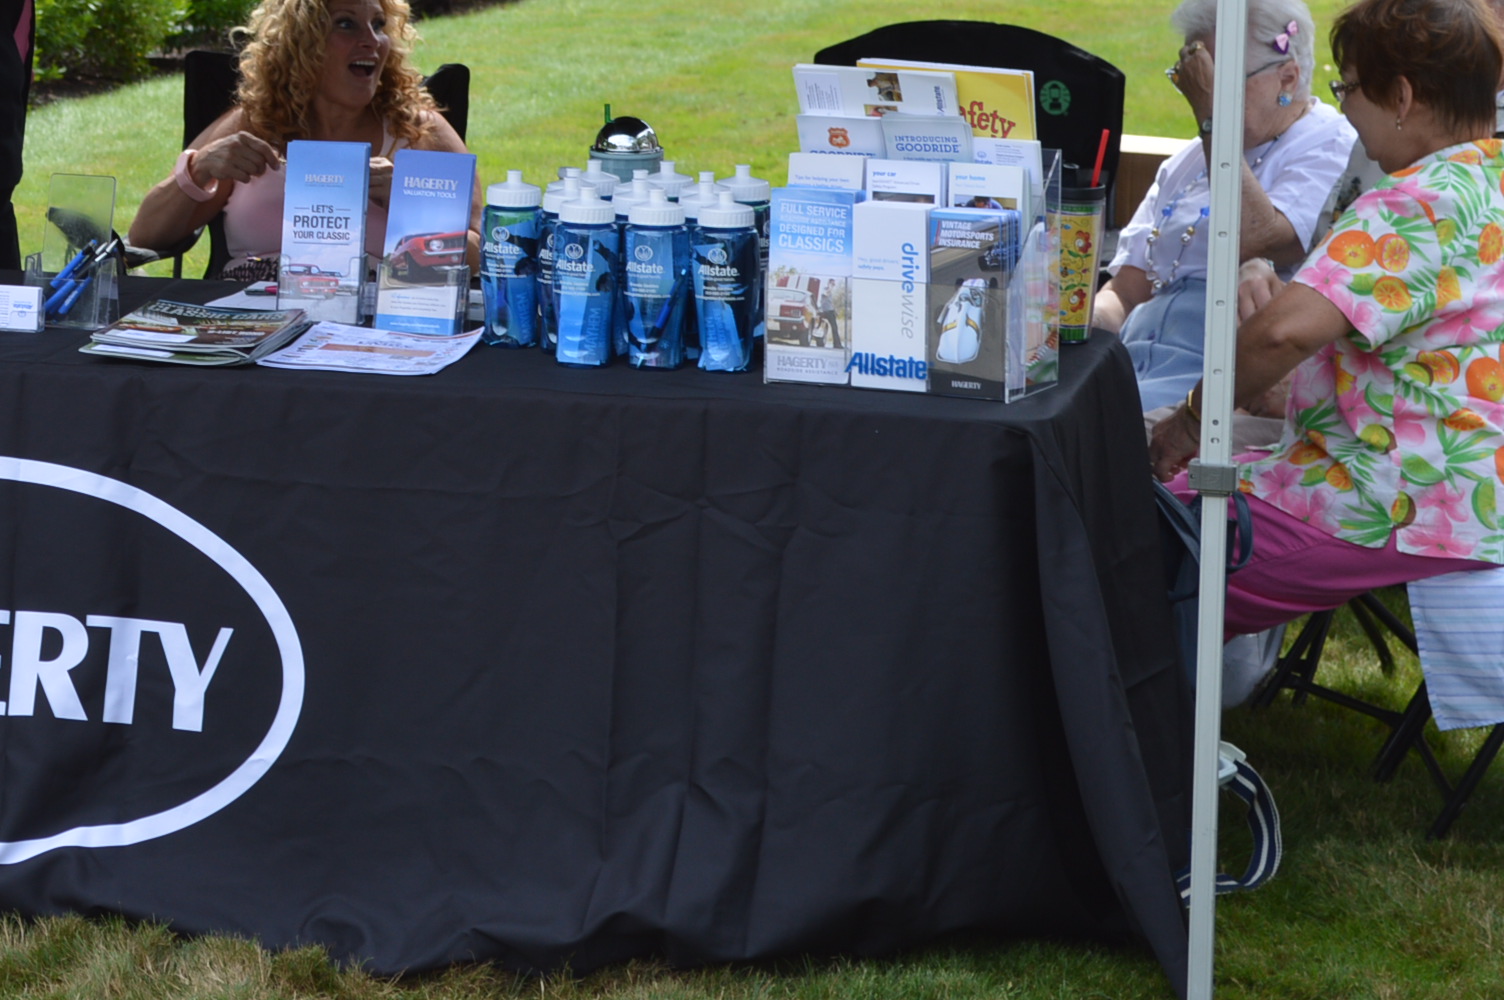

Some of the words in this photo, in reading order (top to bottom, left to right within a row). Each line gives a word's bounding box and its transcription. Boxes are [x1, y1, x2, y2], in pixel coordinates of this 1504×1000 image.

[894, 135, 958, 144] INTRODUCING
[896, 143, 960, 153] GOODRIDE
[304, 173, 345, 184] HAGERTY
[404, 176, 459, 191] HAGERTY
[403, 189, 436, 199] VALUATION
[436, 190, 457, 199] TOOLS
[311, 205, 334, 214] LET'S
[781, 202, 804, 216] FULL
[806, 205, 847, 219] SERVICE
[293, 215, 351, 230] PROTECT
[941, 220, 973, 230] VINTAGE
[293, 230, 314, 240] YOUR
[316, 231, 350, 241] CLASSIC
[779, 223, 825, 236] DESIGNED
[827, 226, 846, 238] FOR
[940, 229, 994, 241] MOTORSPORTS
[483, 242, 521, 255] Allstate
[778, 233, 845, 253] CLASSICS
[938, 238, 981, 249] INSURANCE
[556, 259, 594, 272] Allstate
[626, 261, 664, 274] Allstate
[698, 264, 739, 277] Allstate
[583, 307, 602, 355] MAYHEM
[777, 355, 827, 370] HAGERTY
[844, 352, 929, 381] Allstate
[951, 380, 982, 390] HAGERTY
